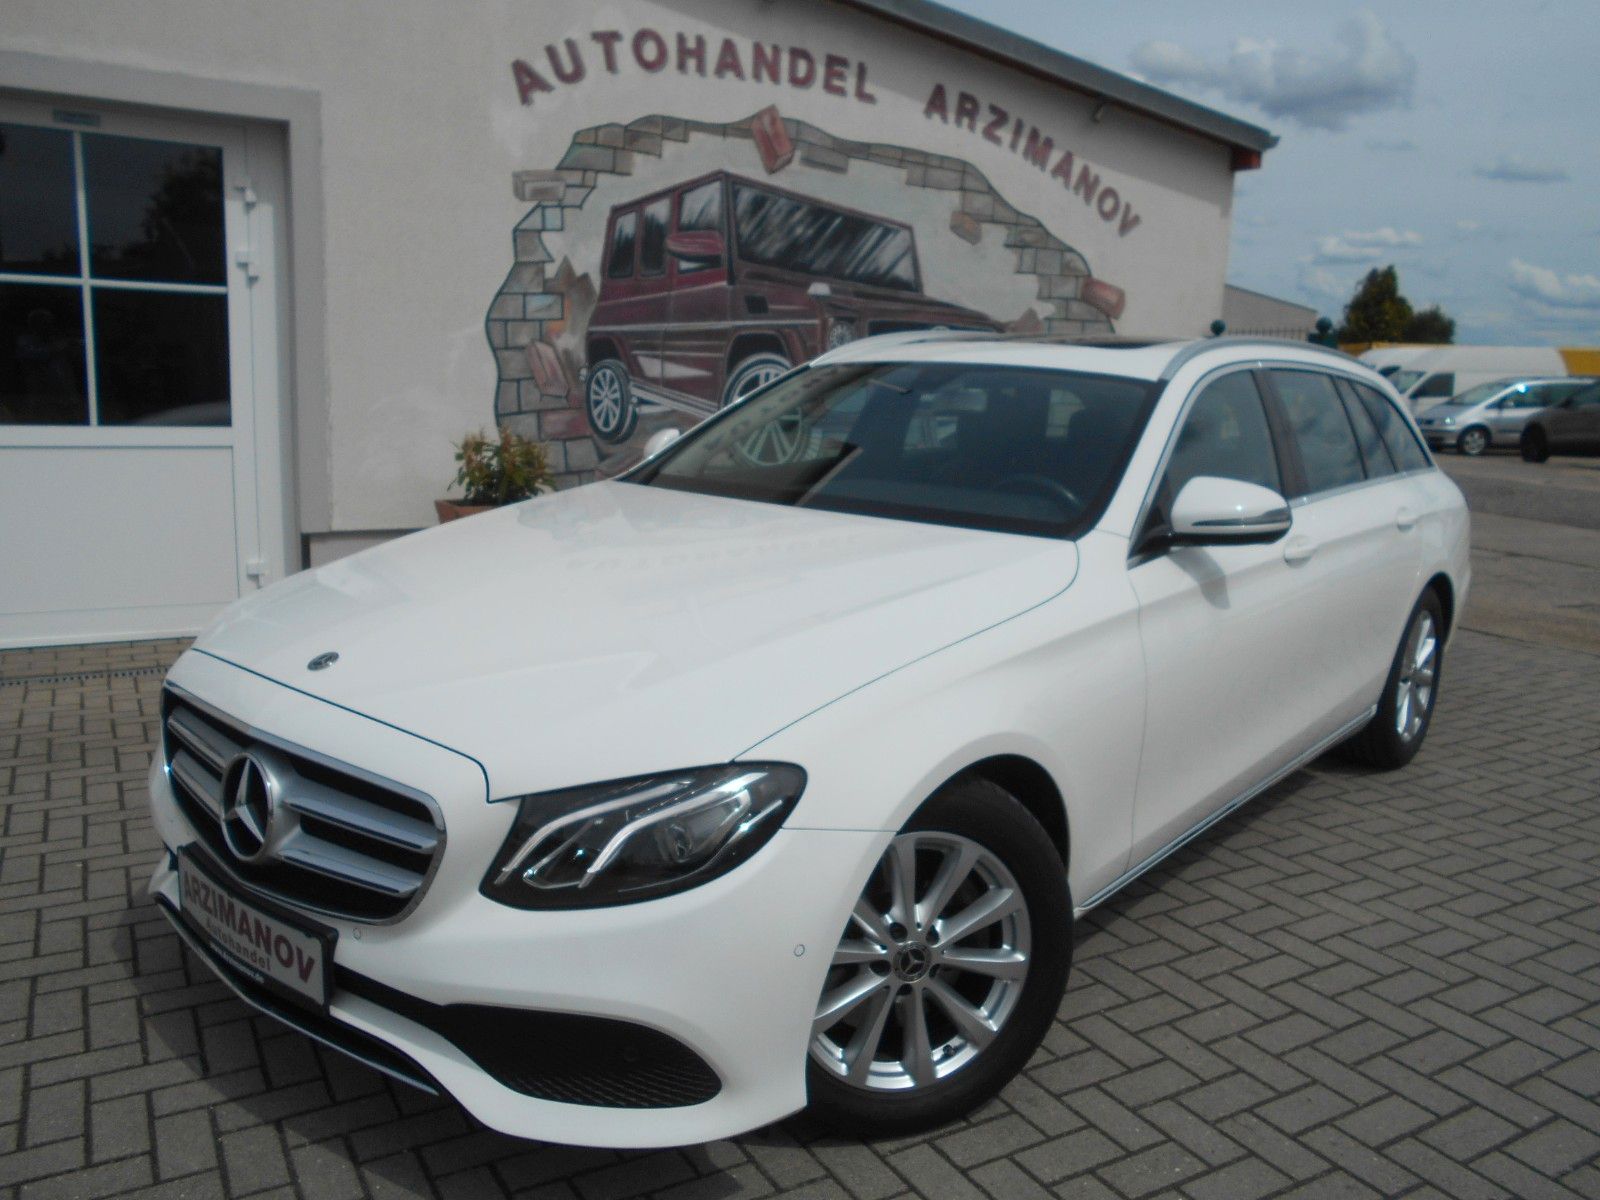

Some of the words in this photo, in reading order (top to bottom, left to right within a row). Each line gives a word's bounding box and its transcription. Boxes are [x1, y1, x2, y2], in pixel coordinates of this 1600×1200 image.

[511, 28, 876, 106] AUTOHANDEL
[923, 83, 1141, 238] ARZIMANOV
[183, 870, 316, 984] ARZIMANOV
